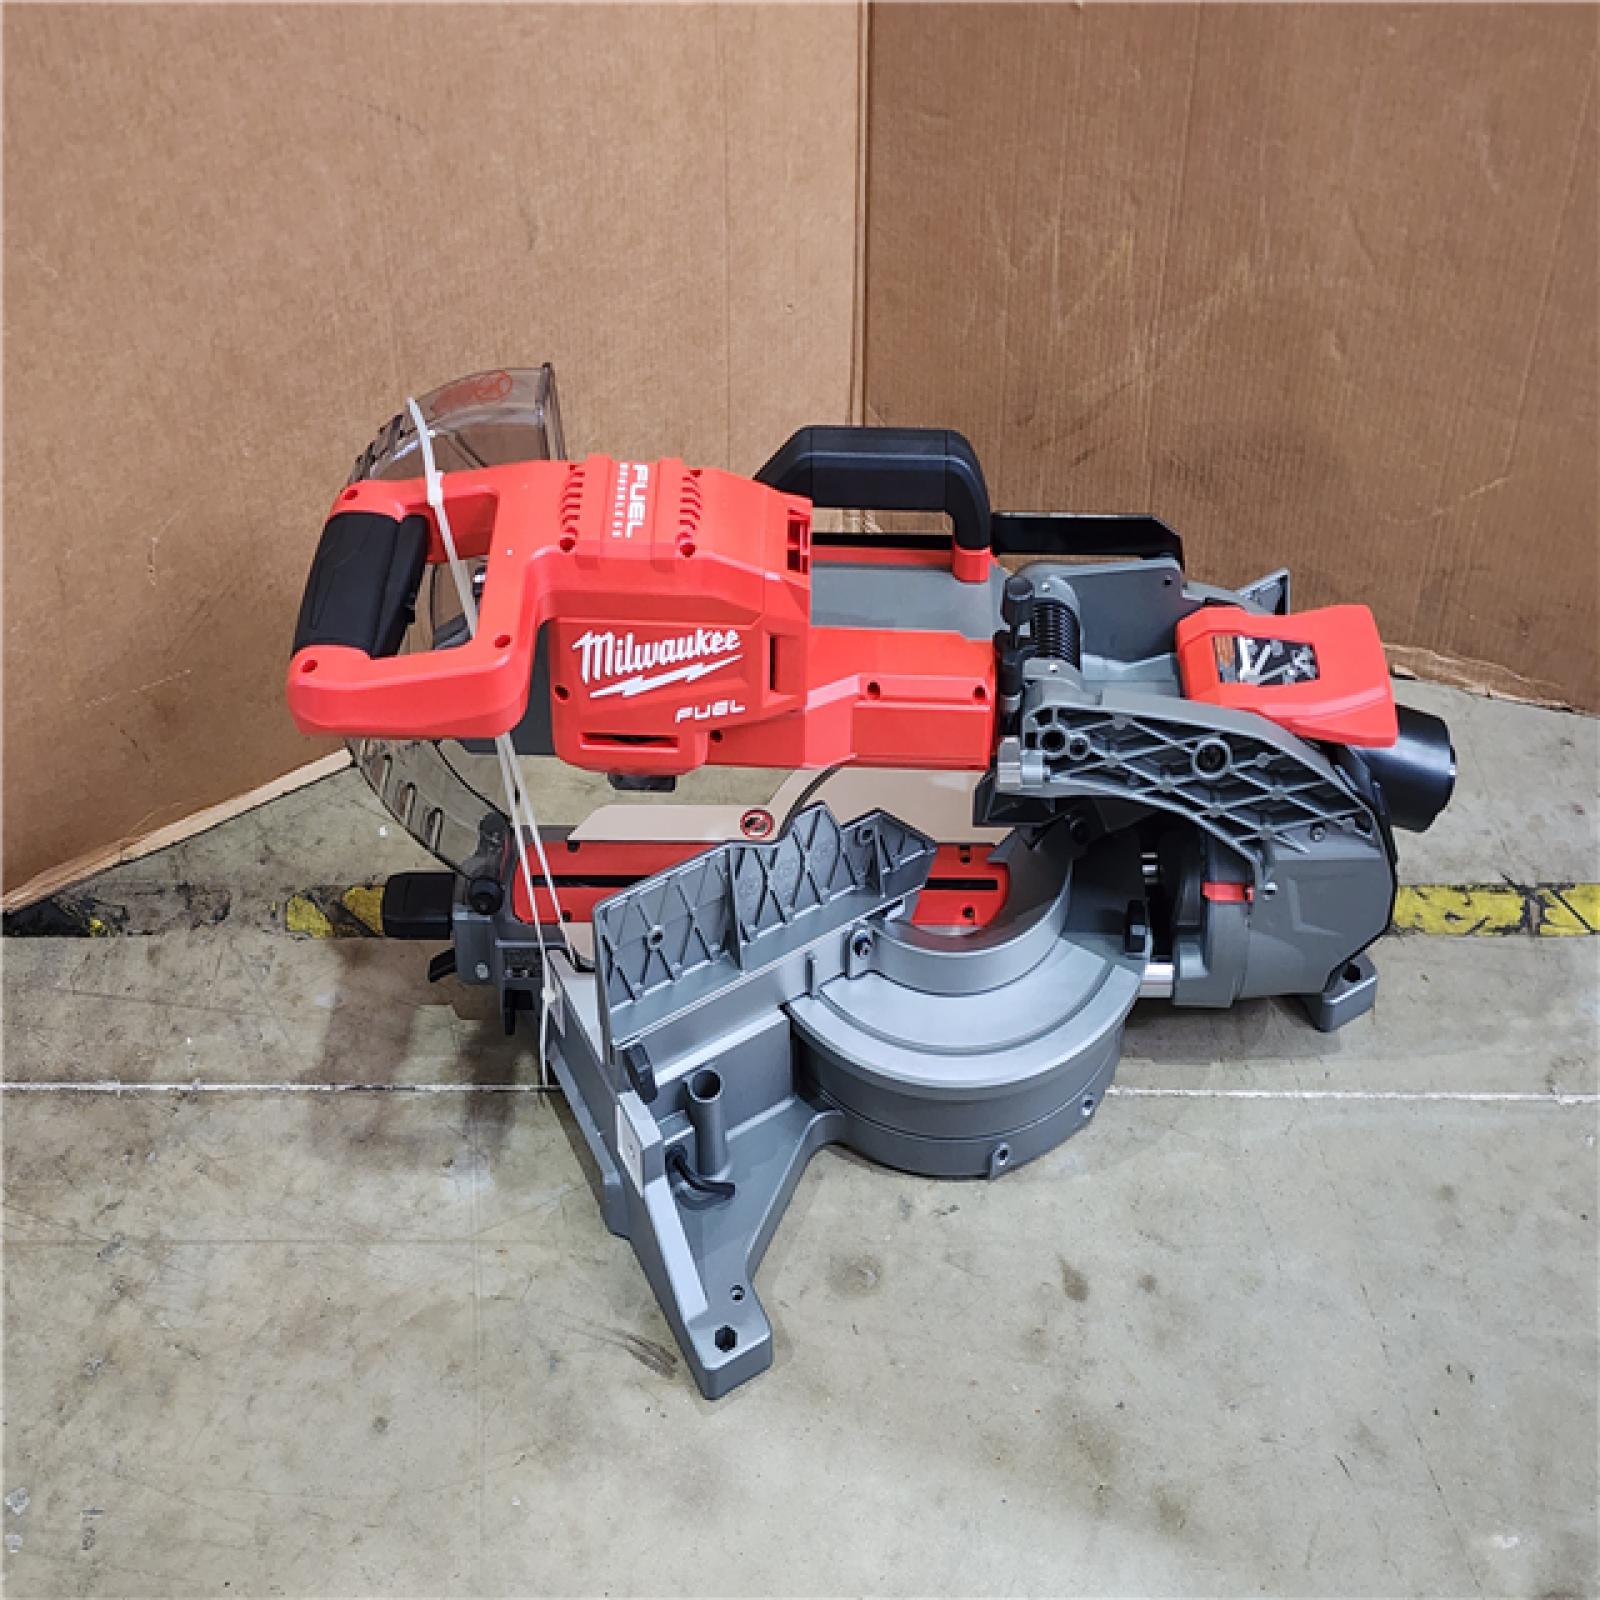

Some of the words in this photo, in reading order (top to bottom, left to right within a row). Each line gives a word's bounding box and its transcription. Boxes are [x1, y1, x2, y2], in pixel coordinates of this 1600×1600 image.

[625, 463, 649, 539] FUEL
[572, 627, 741, 684] Milwaukee
[675, 699, 746, 723] FUEL
